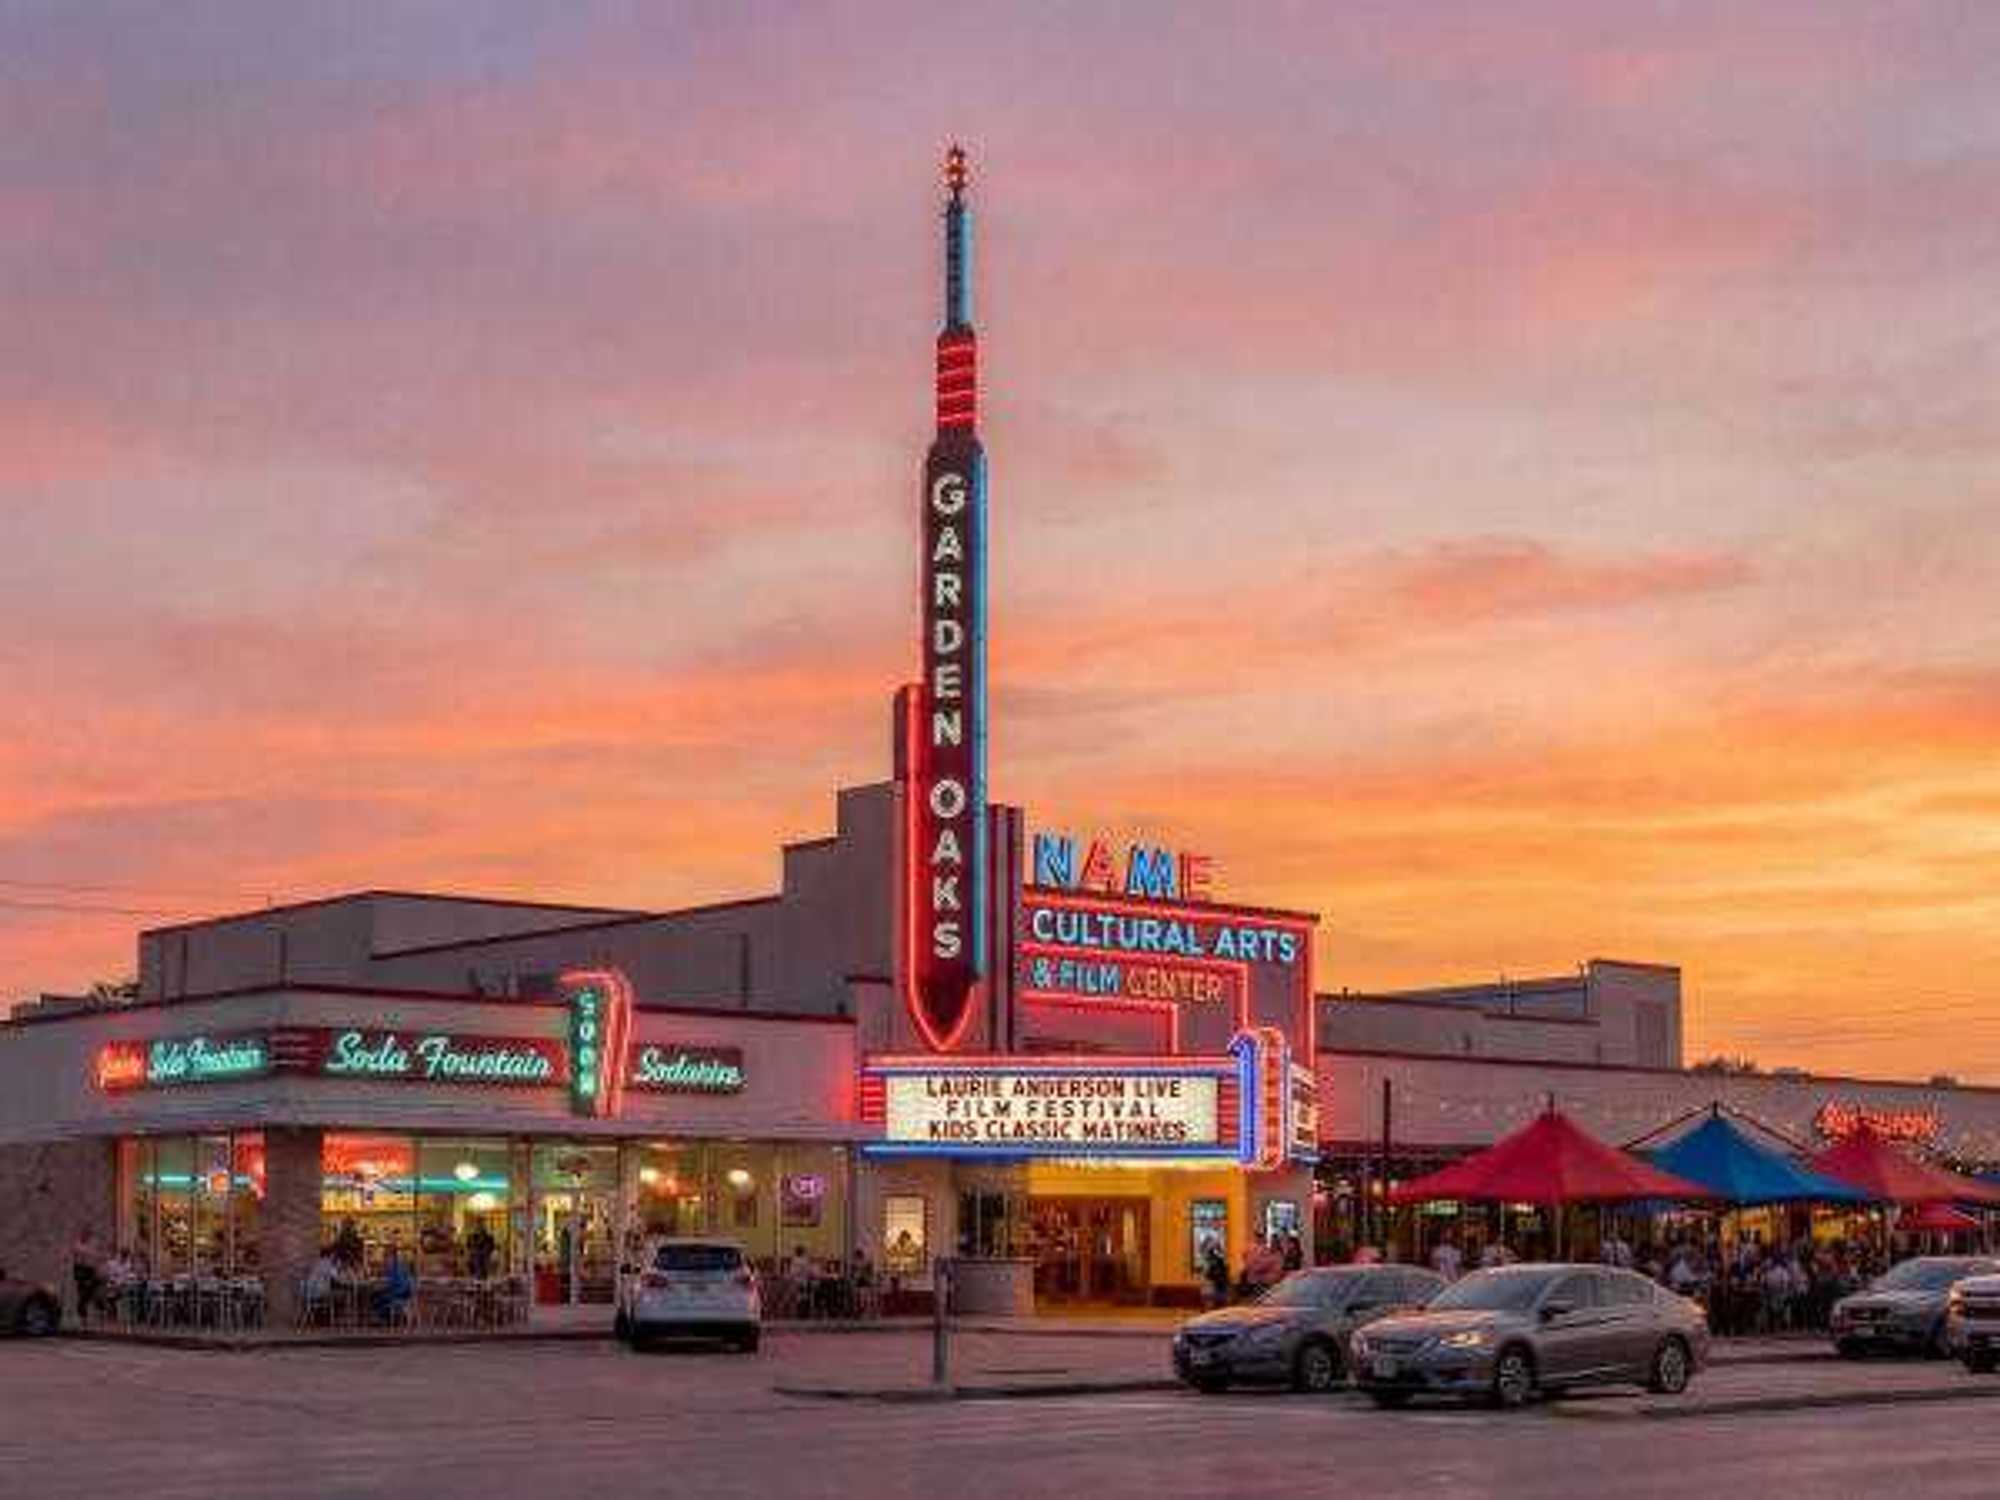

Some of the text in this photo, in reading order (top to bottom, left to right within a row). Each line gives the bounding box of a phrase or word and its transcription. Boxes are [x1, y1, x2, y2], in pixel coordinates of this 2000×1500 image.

[929, 474, 967, 959] GARDEN OAKS
[1033, 909, 1297, 963] CULTURAL ARTS
[1032, 956, 1223, 1002] & FILM CENTER
[326, 1032, 552, 1078] Soda Fountain
[926, 1079, 1183, 1099] LAURIE ANDERSON LIVE
[946, 1100, 1161, 1118] FILM FESTIVAL
[929, 1120, 1188, 1141] KIDS CLASSIC MATINEES
